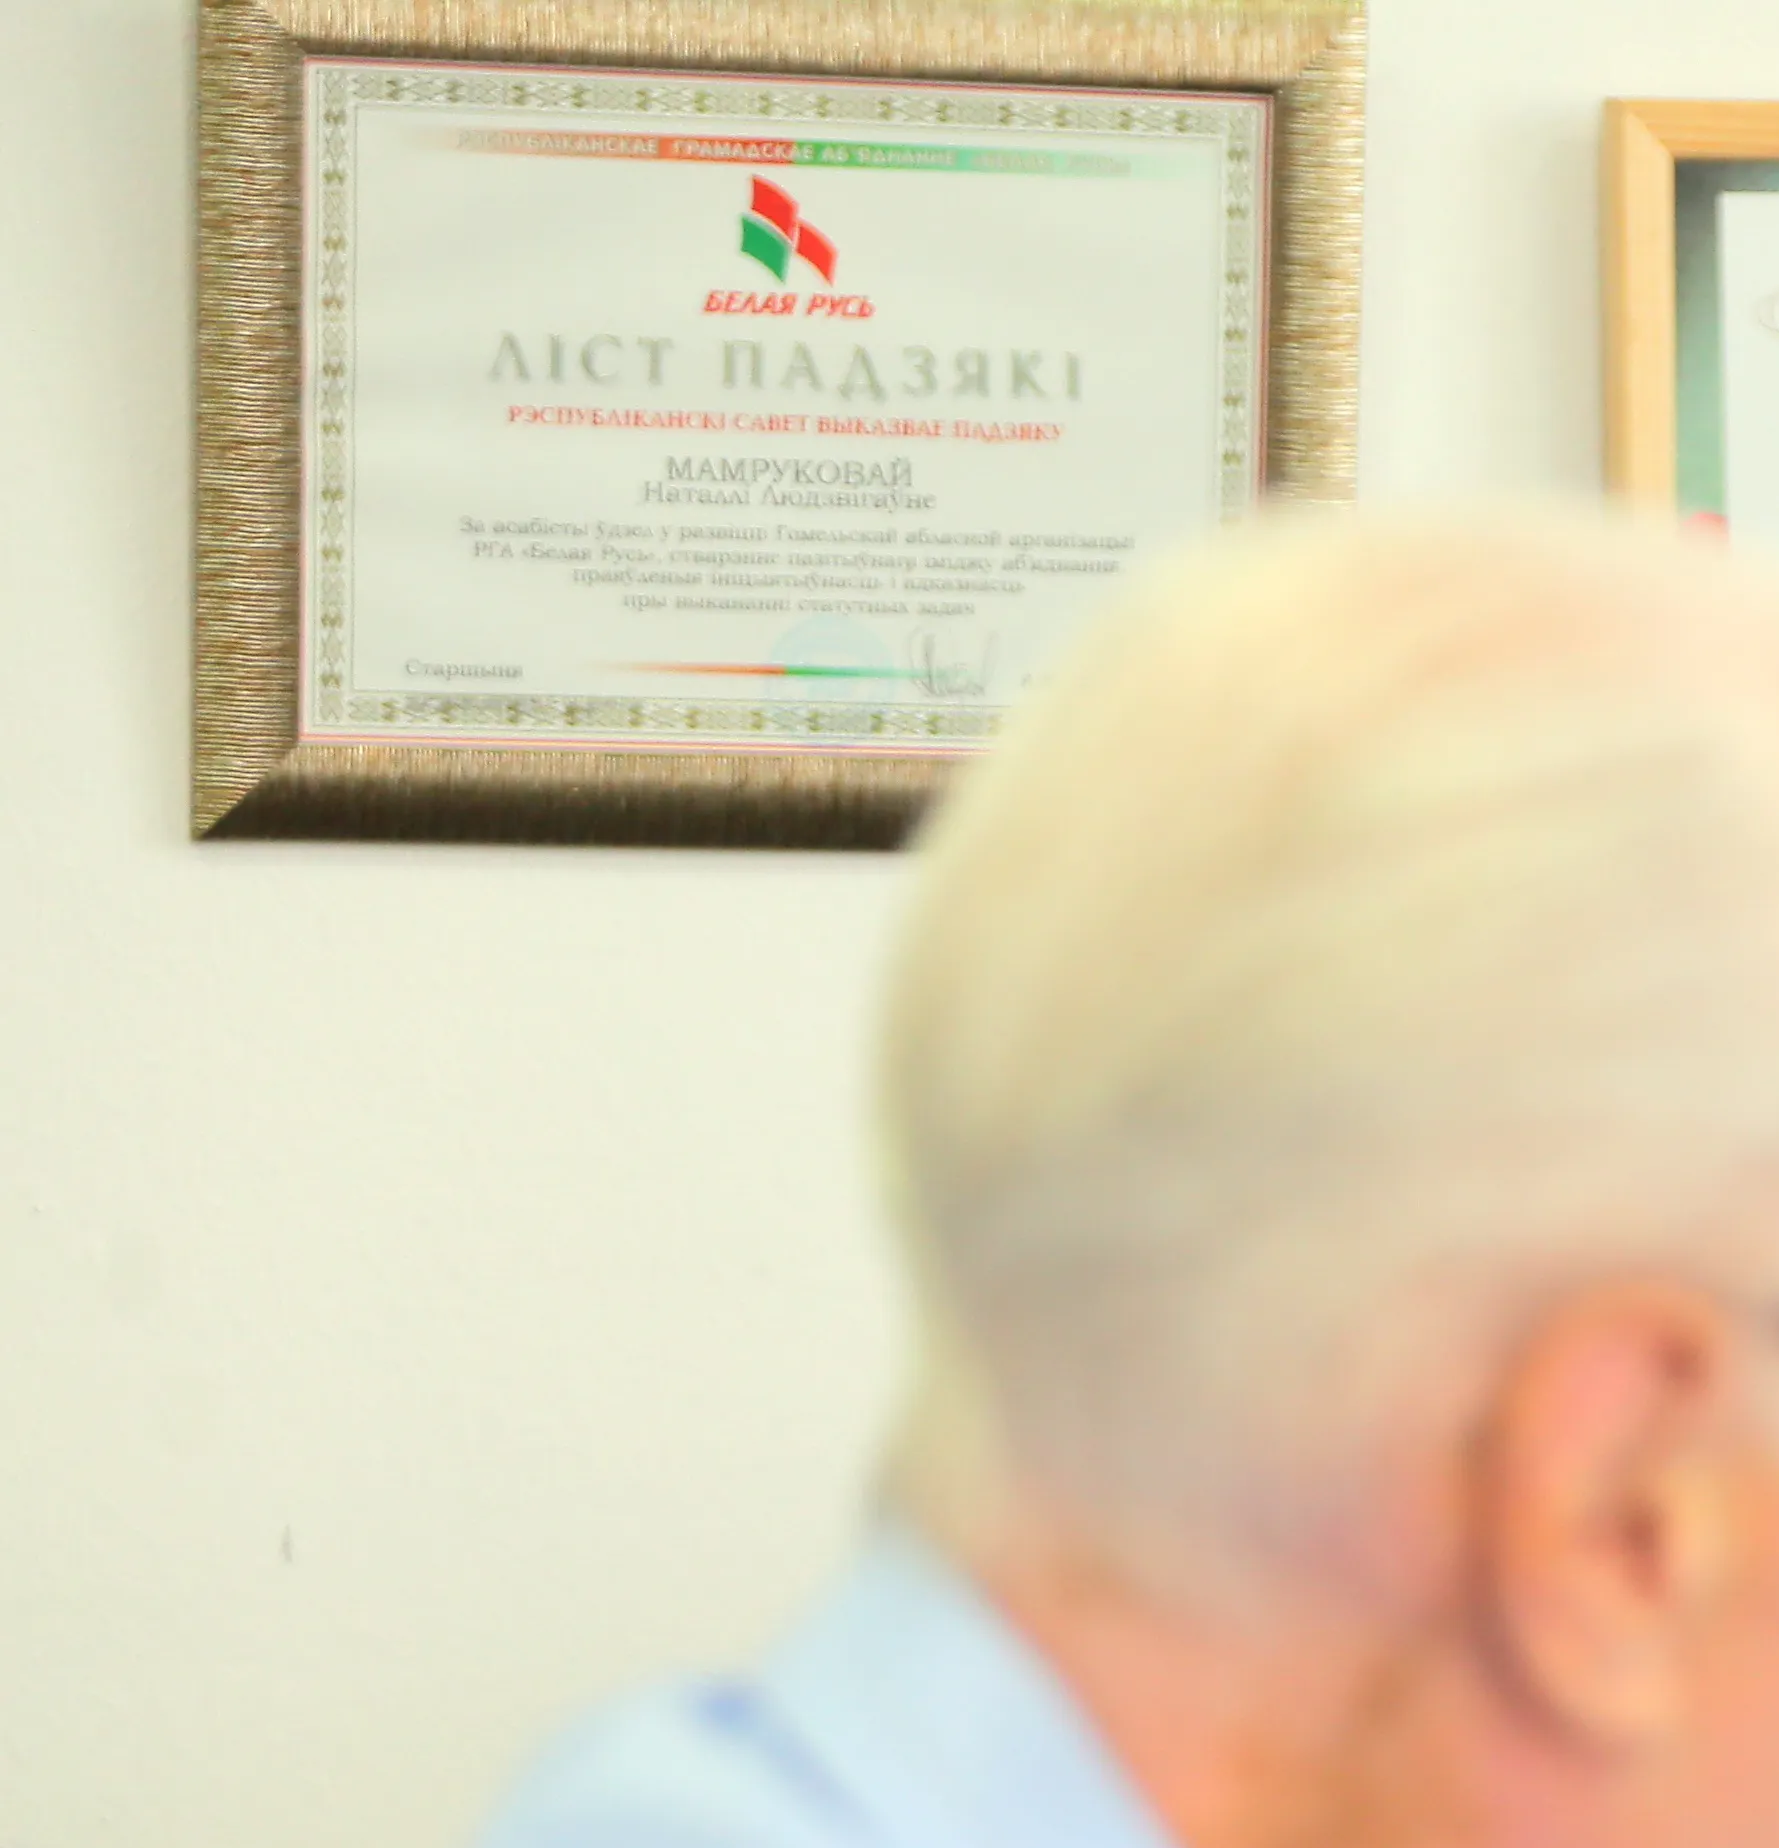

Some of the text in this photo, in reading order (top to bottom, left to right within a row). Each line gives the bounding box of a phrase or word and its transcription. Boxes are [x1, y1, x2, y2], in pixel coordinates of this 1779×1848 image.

[703, 289, 876, 320] БЕЛАЯ РУСЬ
[491, 333, 1080, 401] ЛІСТ ПАДЗЯКІ
[508, 405, 726, 431] РЭСПУБЛІКАНСКІ
[733, 412, 810, 435] САВЕТ
[817, 415, 945, 438] ВЫКАЗВАЕ
[666, 456, 914, 486] МАМРУКОВАЙ
